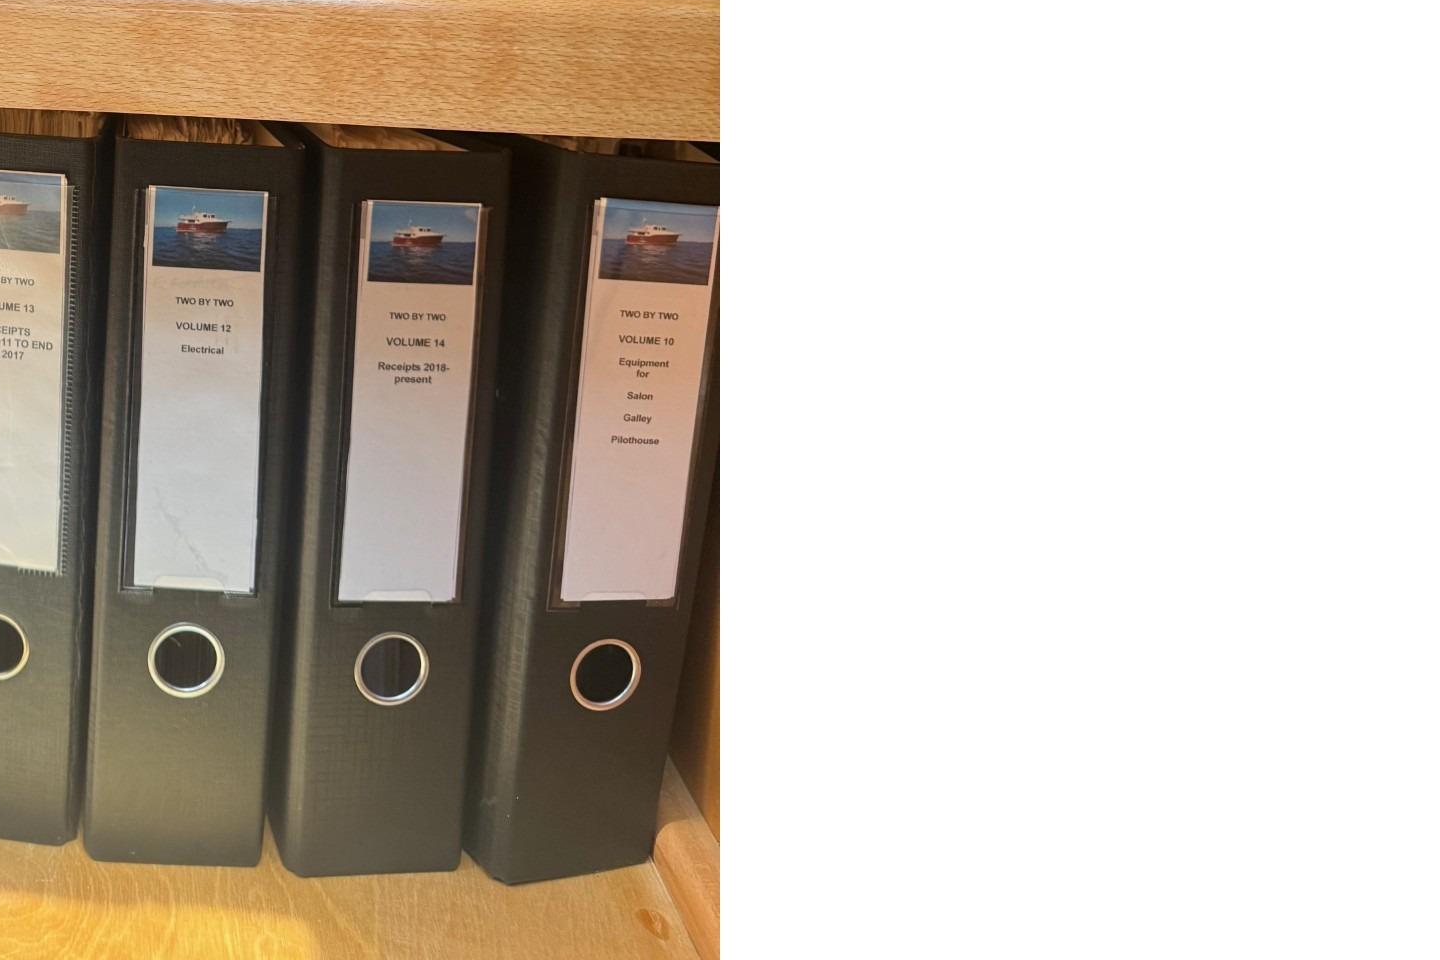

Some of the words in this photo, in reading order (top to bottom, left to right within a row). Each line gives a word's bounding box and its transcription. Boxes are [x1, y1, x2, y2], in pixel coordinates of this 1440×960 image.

[0, 276, 13, 285] BY
[15, 277, 35, 287] TWO
[175, 296, 196, 305] TWO
[198, 297, 211, 306] BY
[213, 298, 234, 308] TWO
[23, 304, 35, 313] 13
[389, 311, 410, 320] TWO
[411, 312, 424, 321] BY
[426, 313, 447, 322] TWO
[619, 309, 641, 319] TWO
[642, 310, 656, 319] BY
[658, 311, 679, 321] TWO
[175, 321, 218, 332] VOLUME
[220, 324, 232, 333] 12
[15, 338, 29, 349] TO
[31, 340, 53, 351] END
[386, 337, 431, 347] VOLUME
[434, 338, 445, 347] 14
[618, 334, 661, 345] VOLUME
[664, 337, 675, 346] 10
[1, 350, 24, 360] 2017
[181, 344, 224, 355] Electrical
[377, 361, 421, 373] Receipts
[423, 363, 450, 372] 2018-
[618, 357, 670, 369] Equipment
[636, 369, 650, 378] for
[394, 375, 432, 385] present
[626, 391, 654, 401] Salon
[623, 413, 652, 425] Galley
[610, 435, 660, 446] Pilothouse
